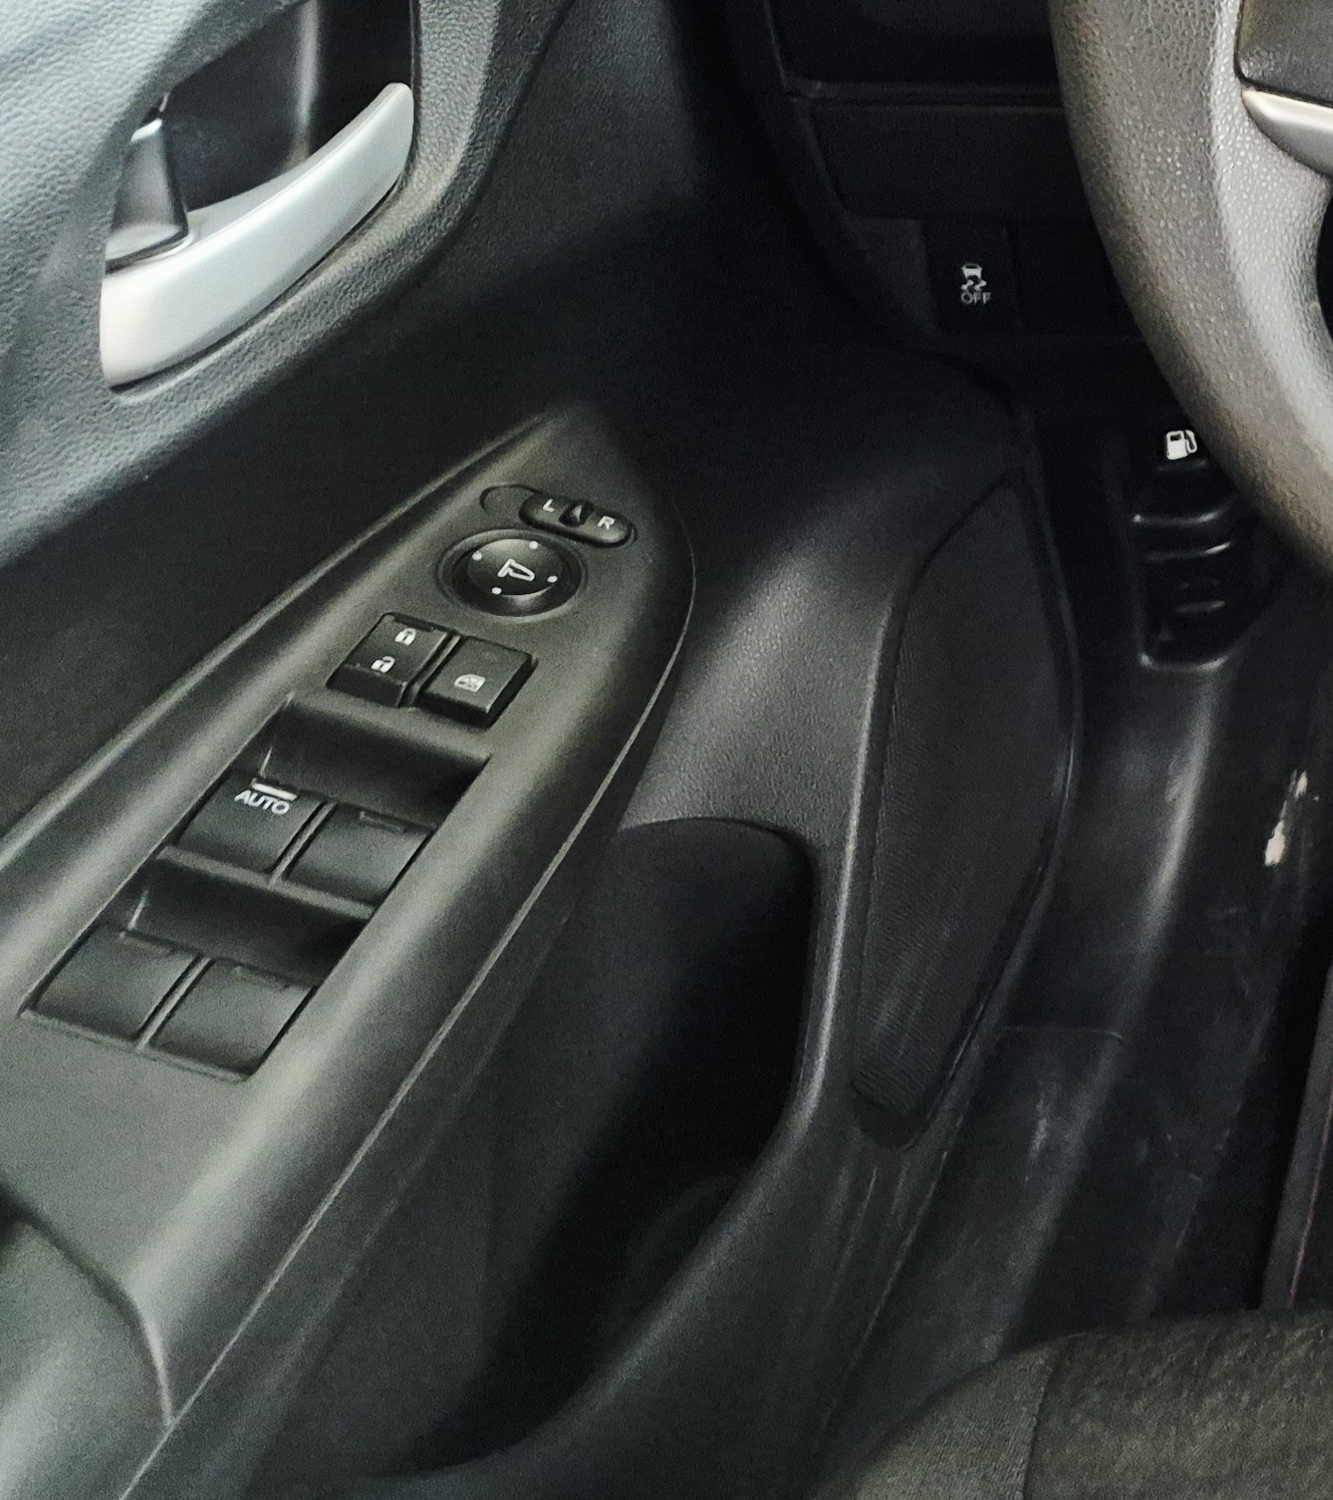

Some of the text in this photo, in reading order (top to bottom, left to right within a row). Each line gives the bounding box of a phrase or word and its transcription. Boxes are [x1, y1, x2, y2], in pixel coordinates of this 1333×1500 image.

[961, 291, 991, 305] OFF
[542, 498, 555, 512] L
[597, 515, 617, 531] R
[234, 787, 290, 815] AUTO
